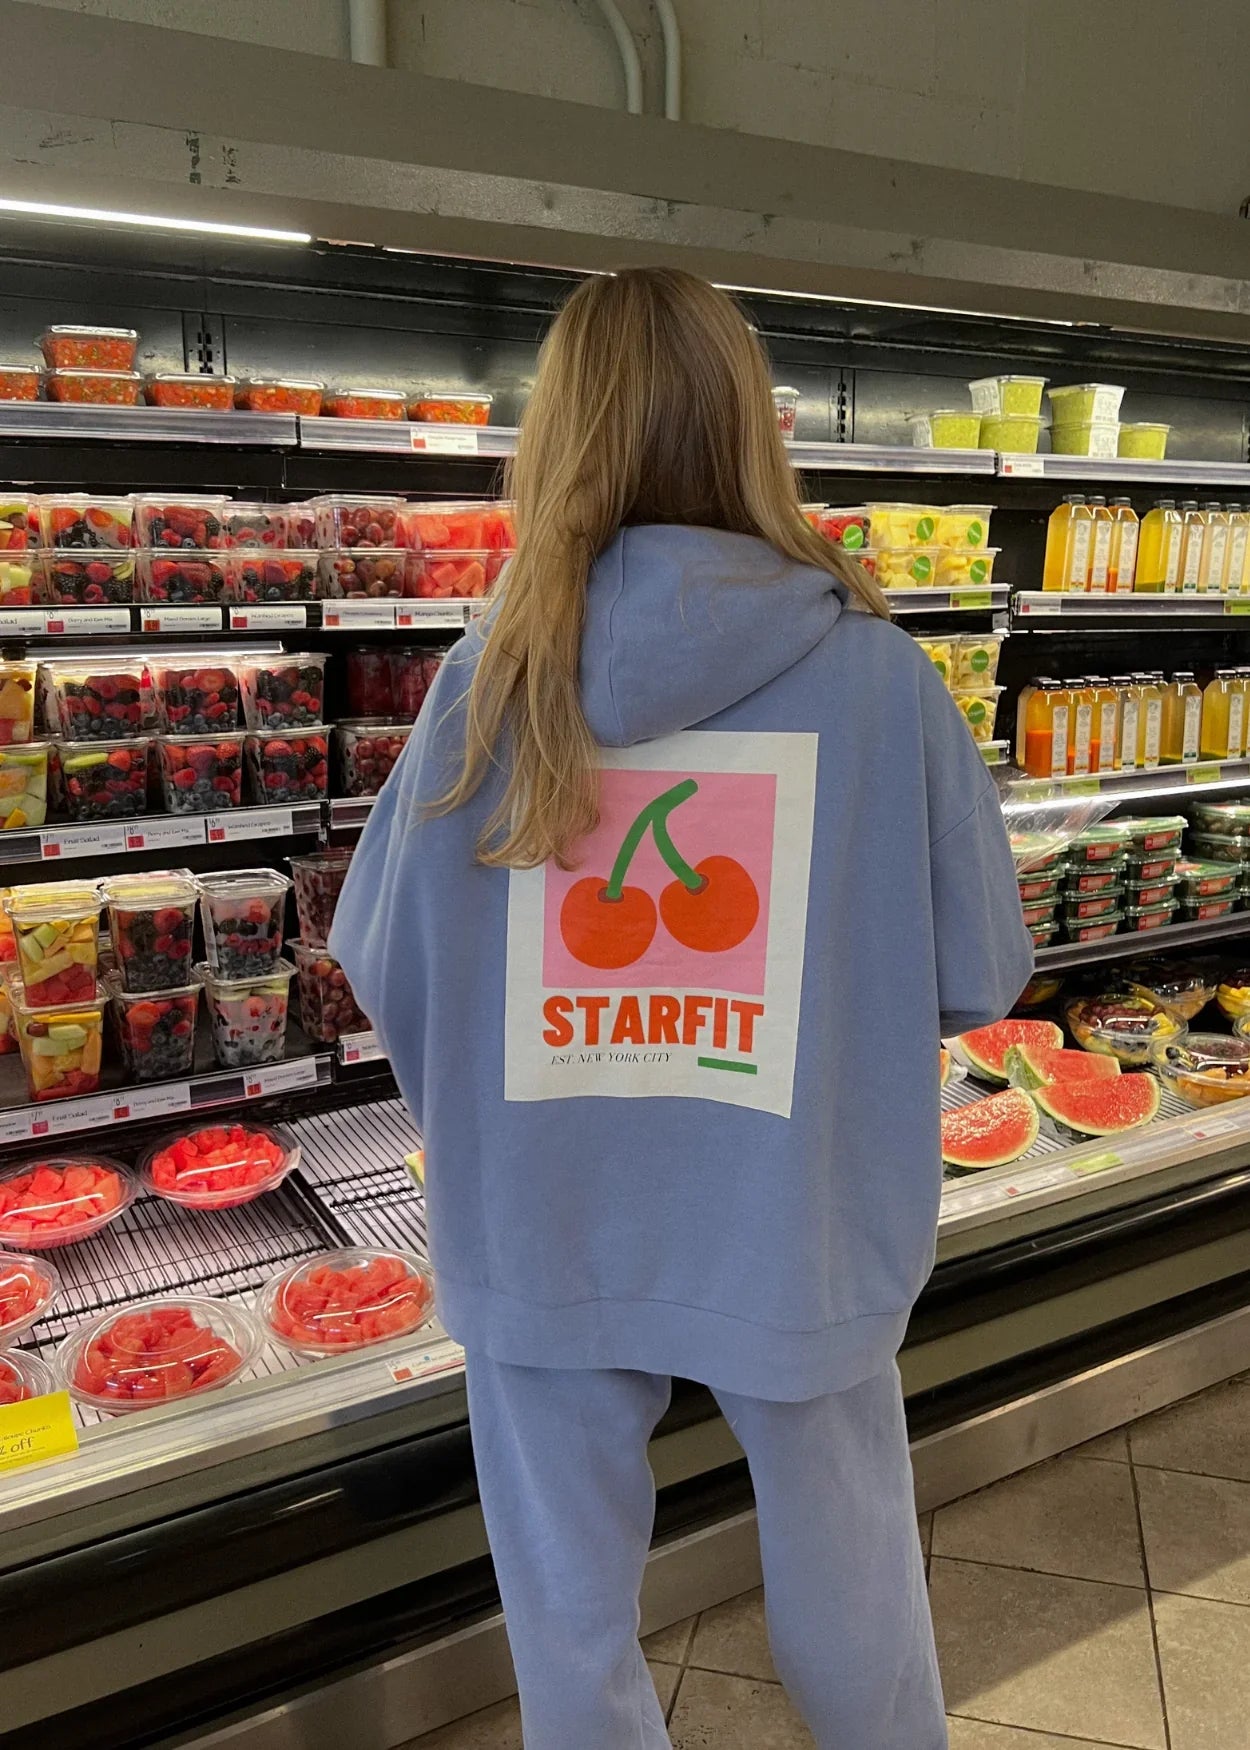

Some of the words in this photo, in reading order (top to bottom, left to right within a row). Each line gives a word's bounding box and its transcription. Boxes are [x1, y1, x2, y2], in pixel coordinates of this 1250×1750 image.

[543, 995, 764, 1053] STARFIT
[578, 1053, 604, 1064] NEW
[608, 1052, 640, 1063] YORK
[643, 1052, 672, 1063] CITY
[10, 1437, 35, 1453] off
